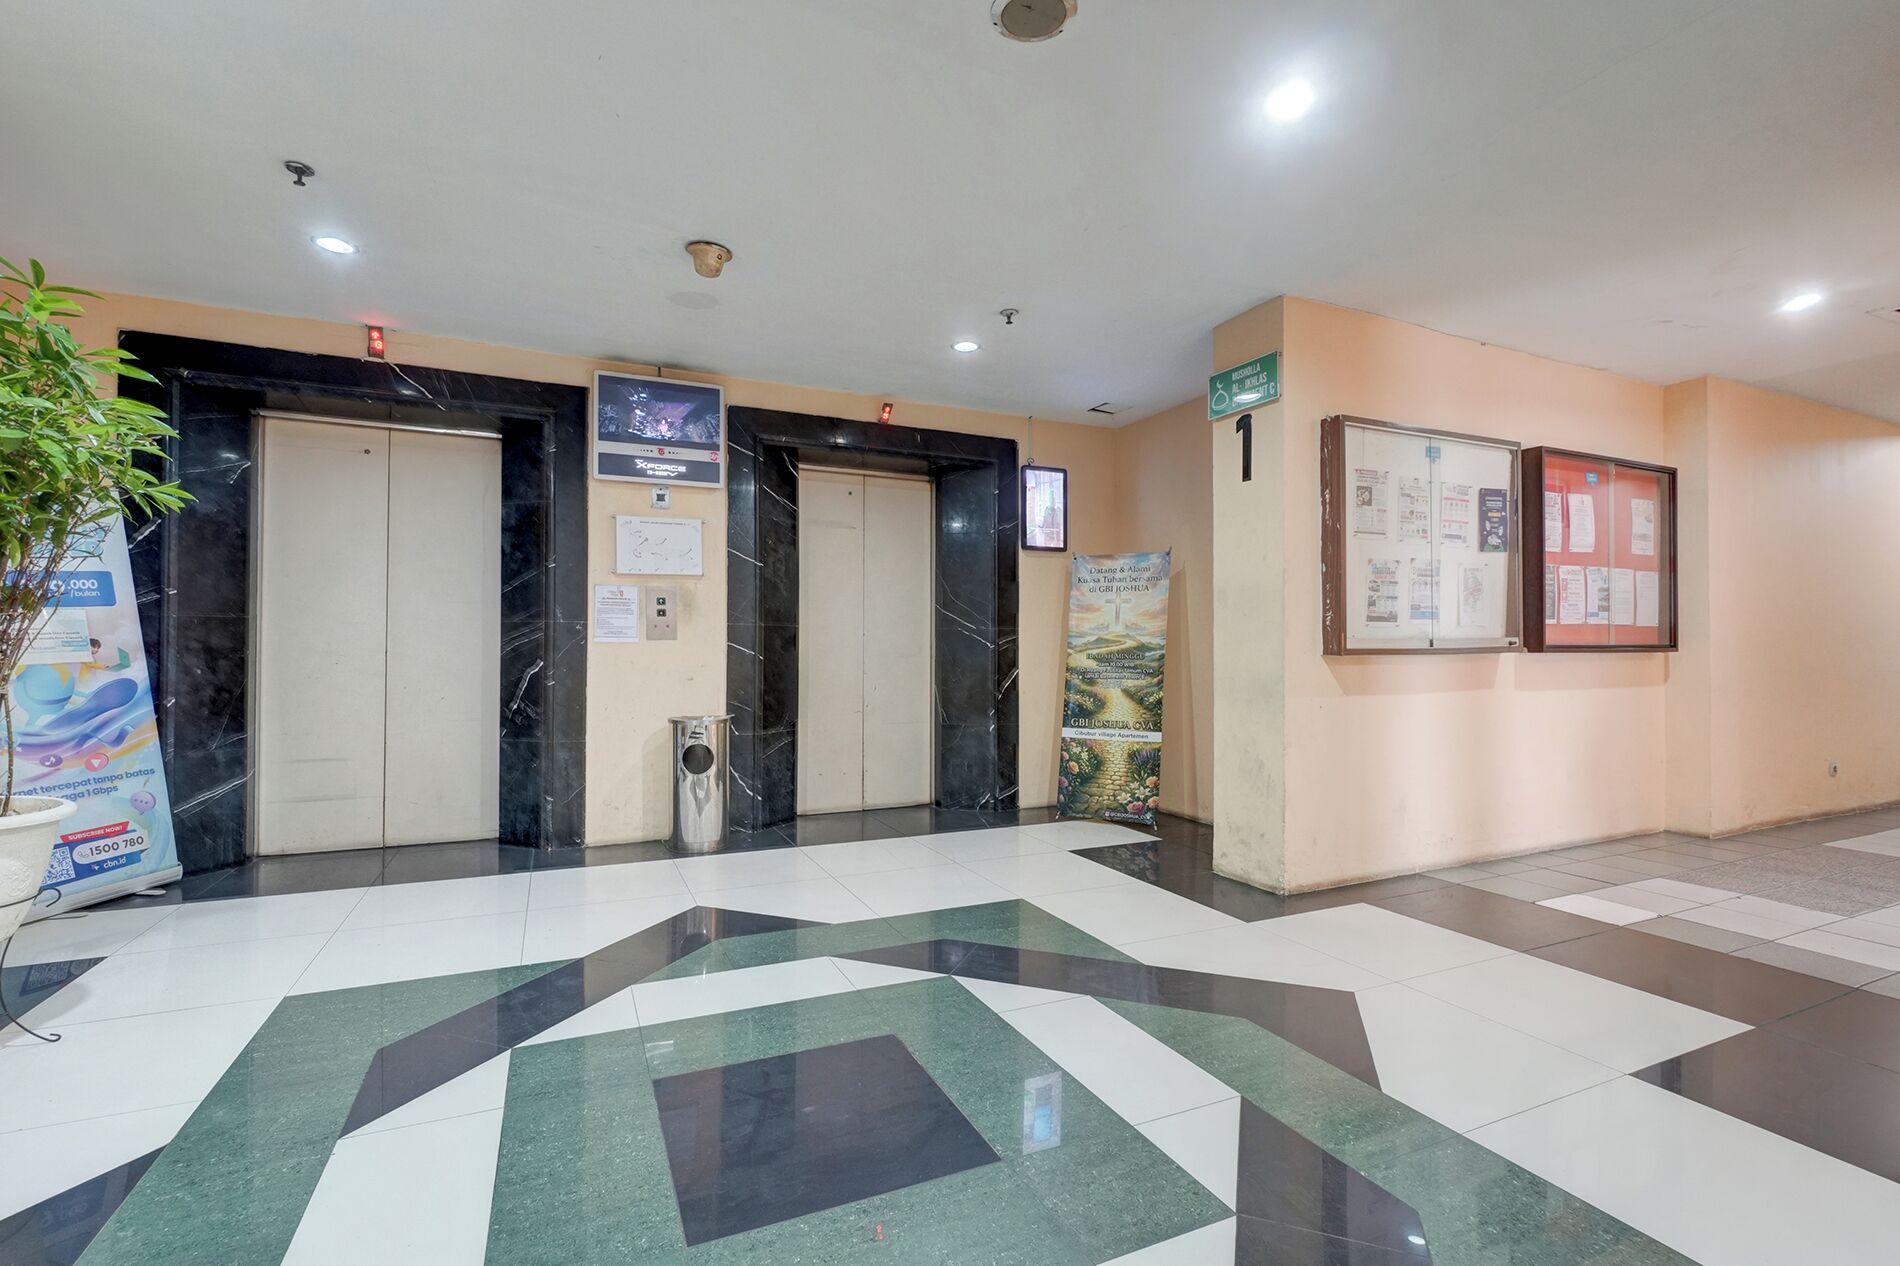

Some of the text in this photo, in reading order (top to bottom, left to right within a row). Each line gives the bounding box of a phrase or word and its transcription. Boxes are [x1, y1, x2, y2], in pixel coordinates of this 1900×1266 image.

[1231, 363, 1261, 381] MUSHOLLA
[1244, 372, 1267, 389] IKHLAS
[1269, 382, 1275, 394] C
[1235, 413, 1253, 483] 1
[635, 458, 687, 472] XFORCE
[1090, 566, 1117, 575] Datang
[1127, 565, 1151, 573] Alami
[1102, 576, 1127, 584] Tuhan
[70, 590, 101, 598] /bulan
[1098, 585, 1113, 593] GBI
[1114, 584, 1150, 594] JOSHUA
[1070, 717, 1154, 730] GBI JOSHUA CVA
[40, 778, 93, 793] tercepat
[92, 774, 124, 785] tanpa
[125, 767, 156, 778] batas
[93, 785, 119, 798] Gbps
[68, 825, 123, 841] SUBSCRIBE NOW!
[89, 835, 145, 857] 1500 780
[103, 855, 127, 869] cbn.id
